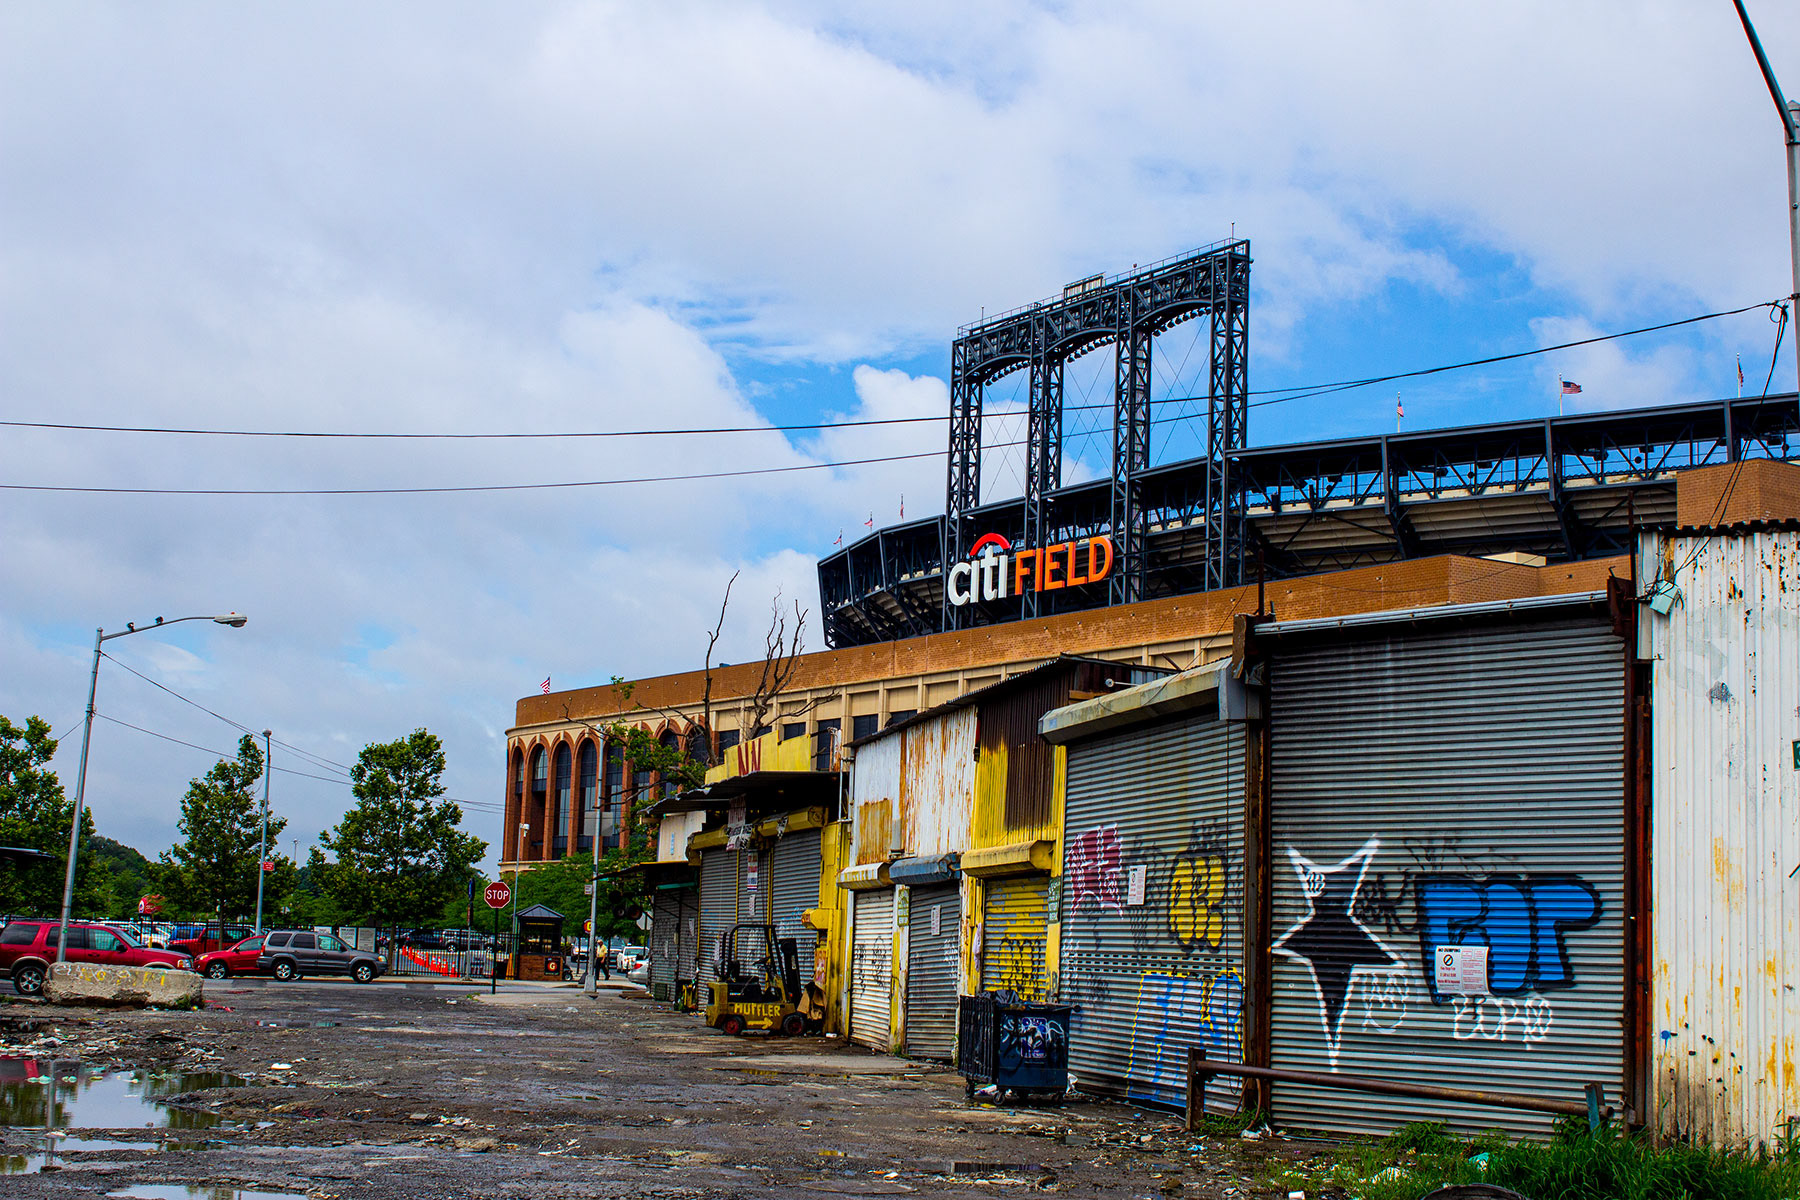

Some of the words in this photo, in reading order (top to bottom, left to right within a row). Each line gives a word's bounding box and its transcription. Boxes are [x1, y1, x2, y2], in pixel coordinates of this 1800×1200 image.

[947, 544, 1009, 607] citi
[1014, 536, 1114, 596] FIELD
[486, 889, 509, 900] STOP
[734, 1002, 781, 1017] MUFFLER
